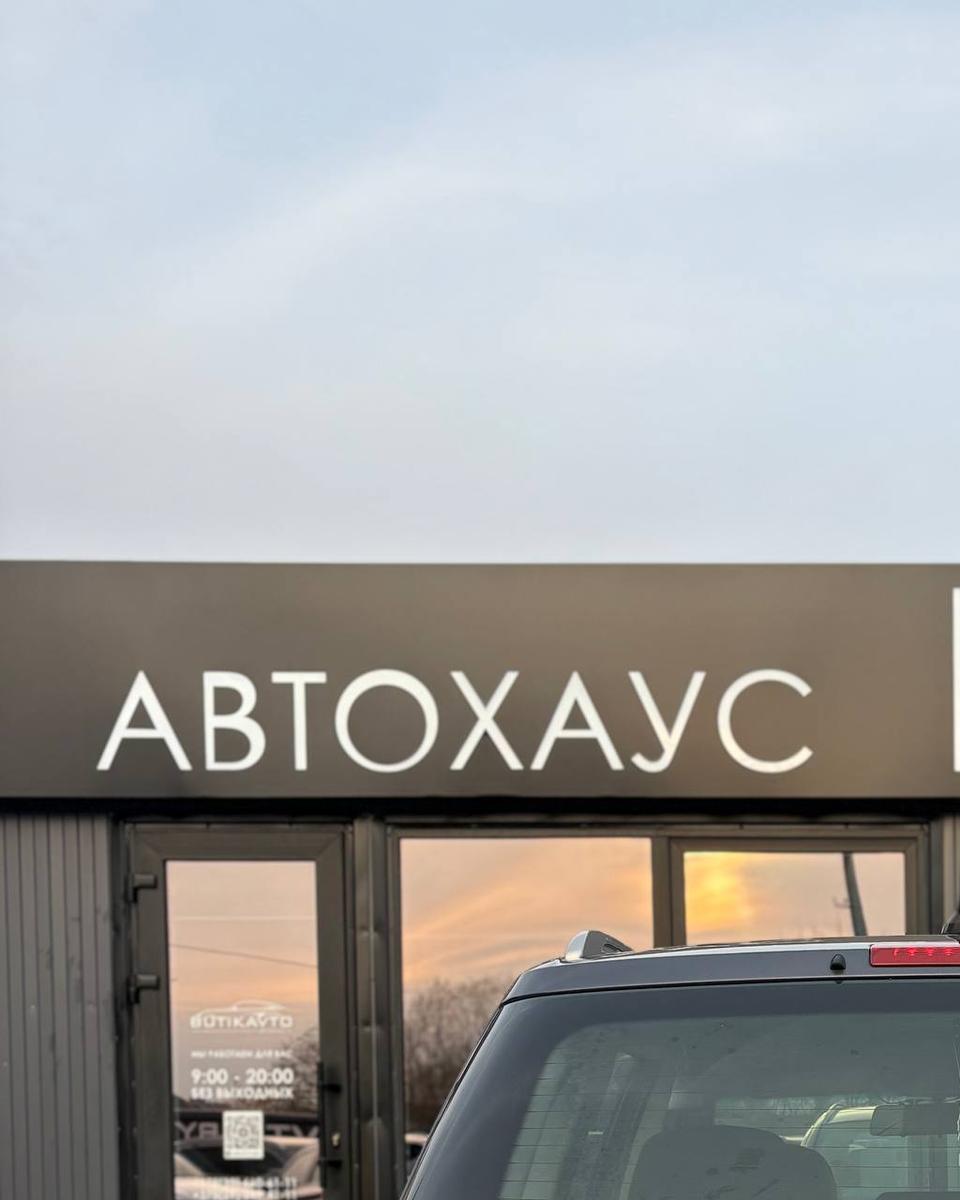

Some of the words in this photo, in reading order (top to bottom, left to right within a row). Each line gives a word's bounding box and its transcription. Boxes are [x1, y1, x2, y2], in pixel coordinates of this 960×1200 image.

[97, 668, 813, 774] АВТОХАУС
[189, 1015, 293, 1029] BUTIKAVTO
[191, 1067, 228, 1085] 9:00
[245, 1067, 294, 1085] 20:00
[191, 1086, 213, 1100] БЕЗ
[215, 1086, 295, 1100] ВЫХОДНЫХ
